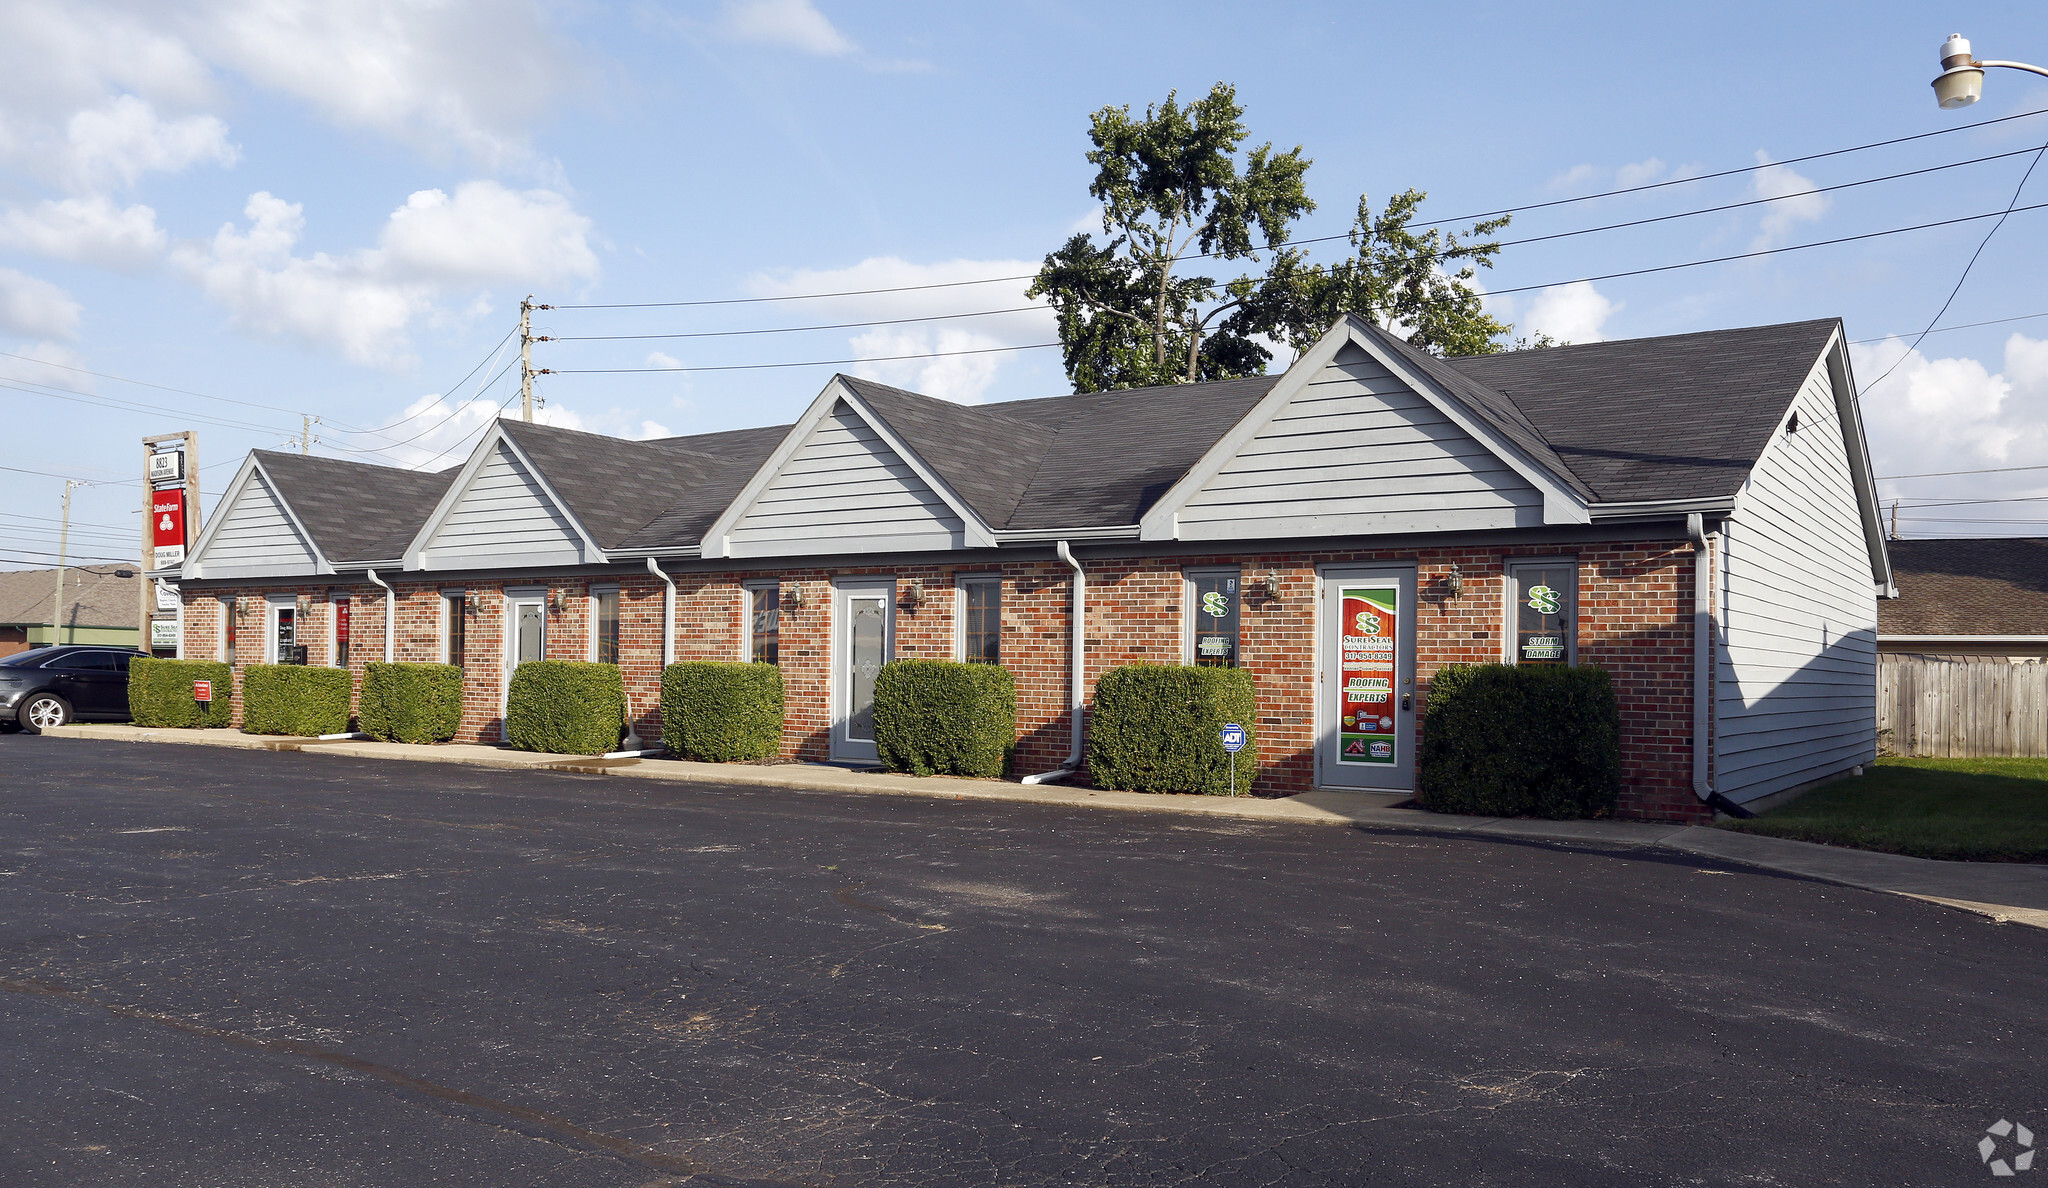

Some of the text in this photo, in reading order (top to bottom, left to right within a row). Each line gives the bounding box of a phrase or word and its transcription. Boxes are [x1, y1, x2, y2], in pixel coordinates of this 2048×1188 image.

[156, 456, 168, 469] 8823
[166, 550, 180, 558] MILLER
[1202, 637, 1229, 645] ROOFING
[1344, 635, 1392, 644] SURE SEAL
[1529, 637, 1559, 646] STORM
[1201, 648, 1228, 656] EXPERTS
[1345, 652, 1393, 660] 317-954-8349
[1526, 650, 1560, 658] DAMAGE
[1348, 678, 1389, 688] ROOFING
[1348, 693, 1387, 703] EXPERTS
[1223, 732, 1241, 743] ADT
